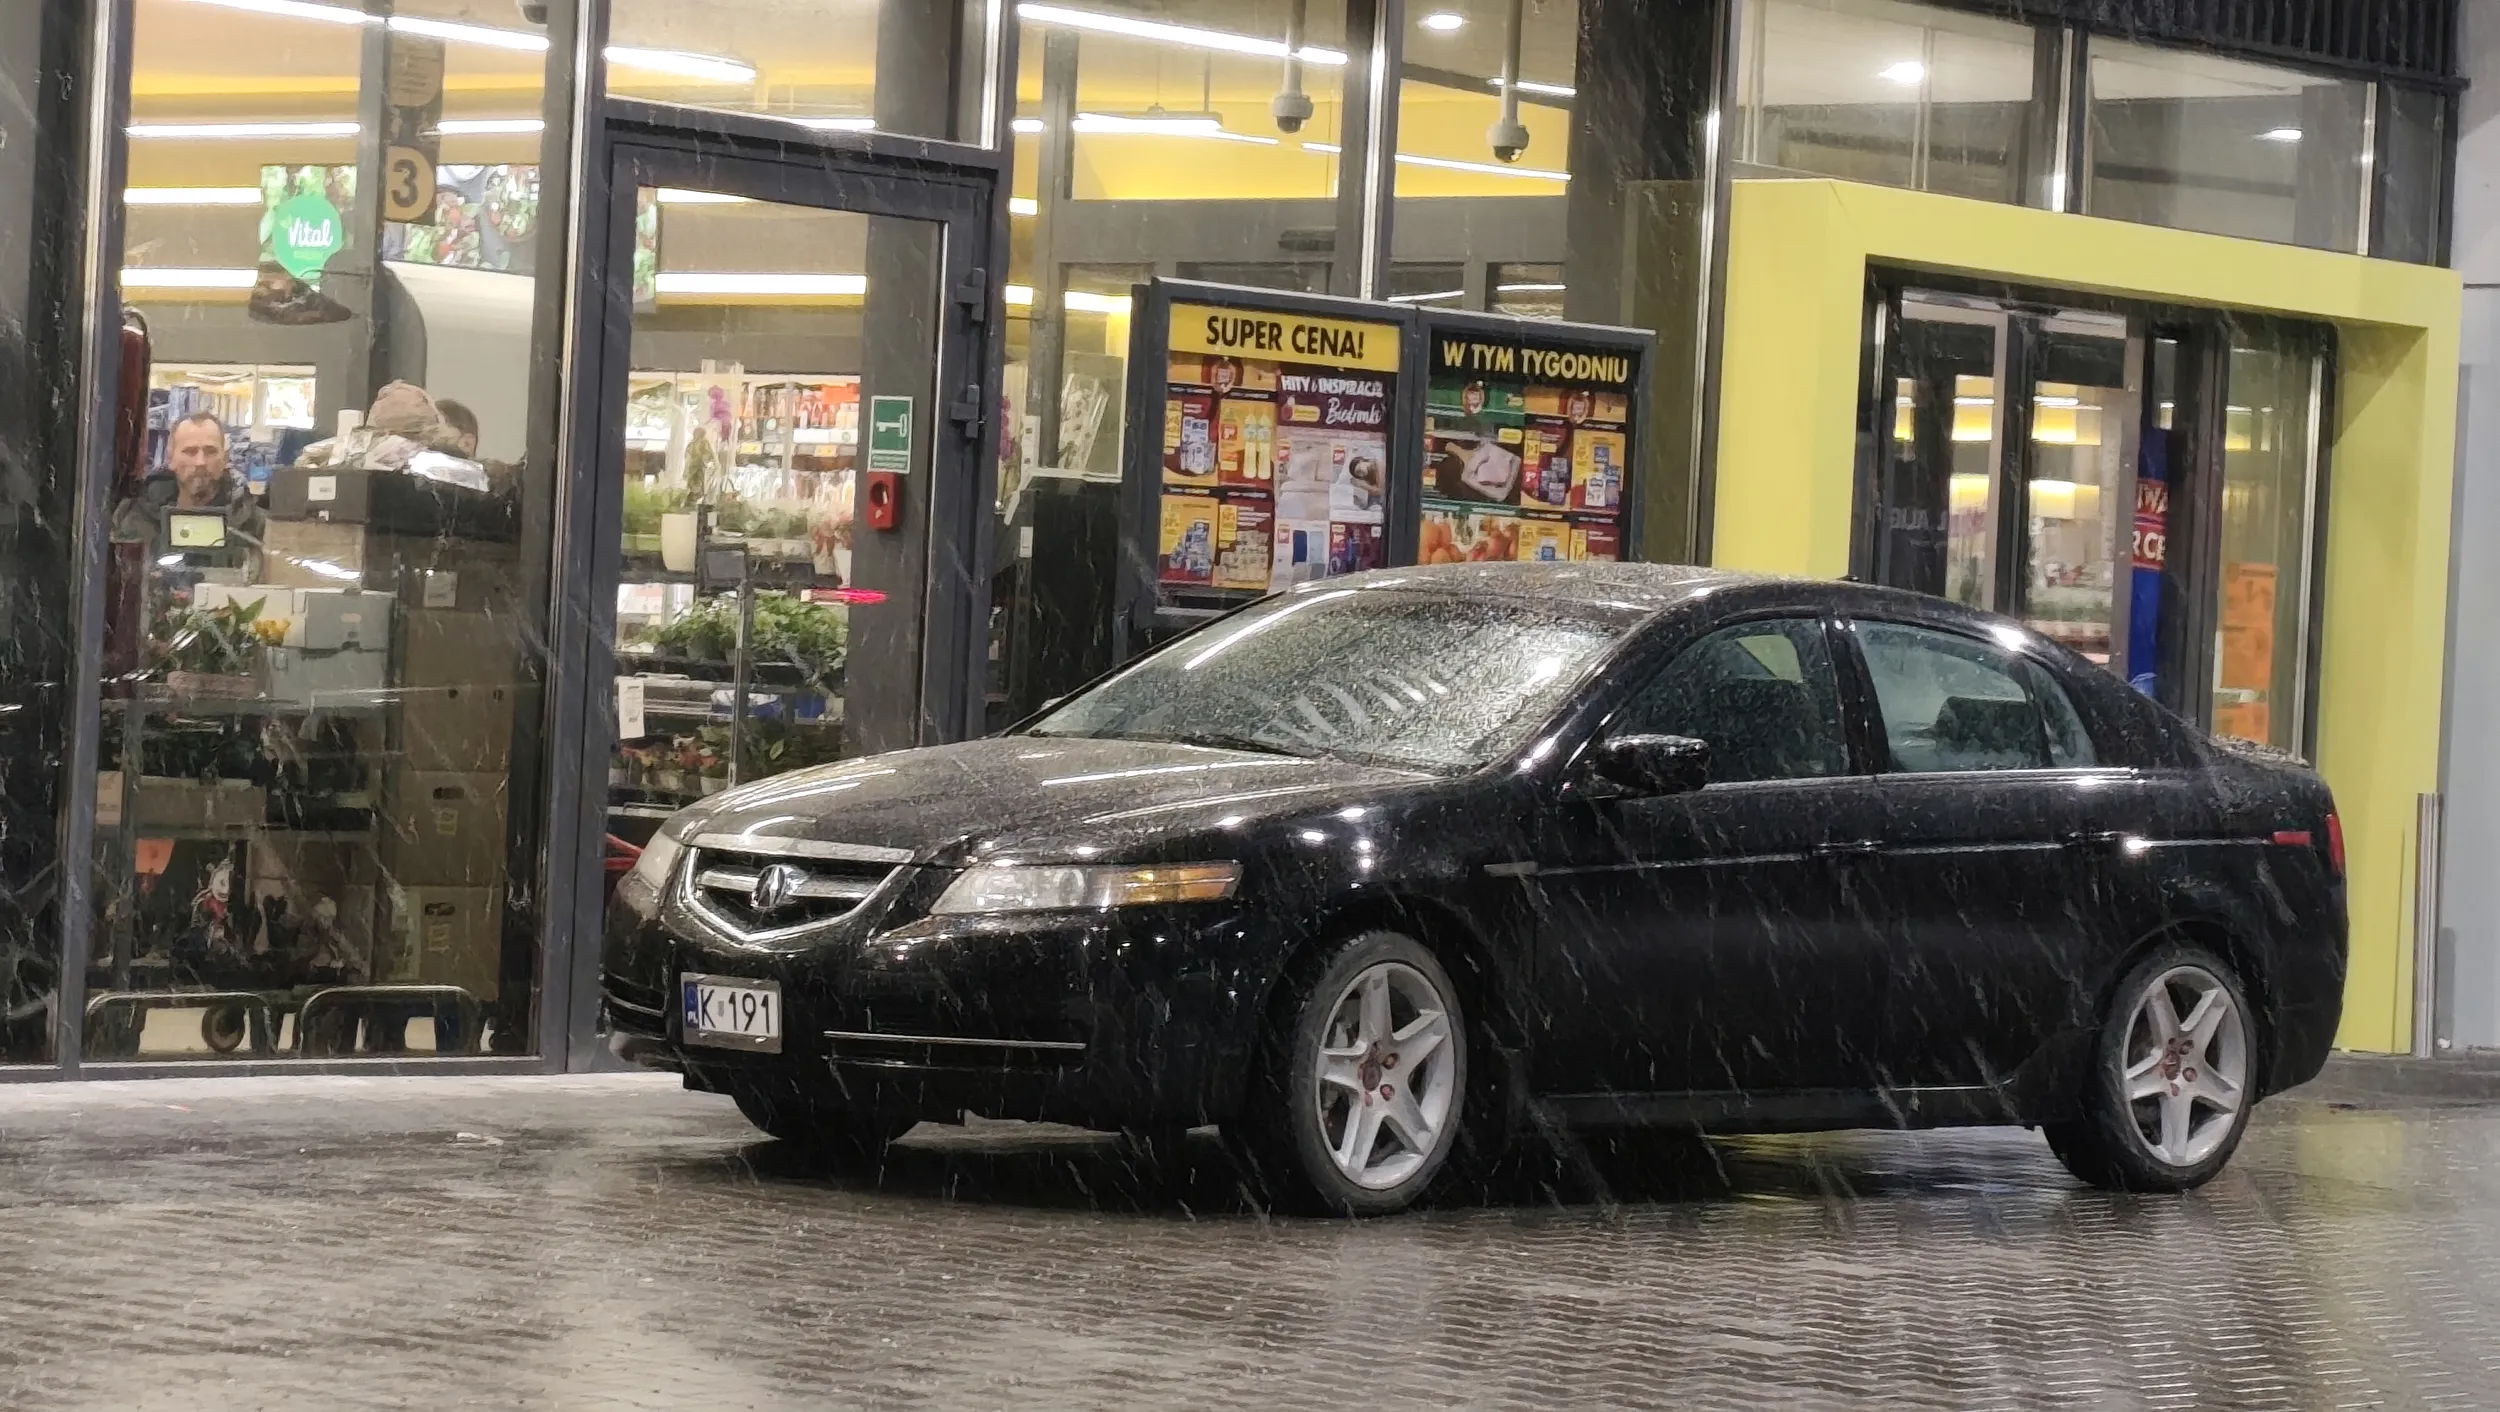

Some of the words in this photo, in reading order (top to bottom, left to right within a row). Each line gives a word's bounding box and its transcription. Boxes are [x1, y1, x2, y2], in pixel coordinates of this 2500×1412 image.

[391, 159, 419, 208] 3
[288, 216, 334, 248] Vital
[1206, 315, 1283, 352] SUPER
[1291, 324, 1365, 360] CENA!
[1442, 339, 1467, 368] W
[1471, 343, 1515, 373] TYM
[1521, 348, 1629, 383] TYGODNIU
